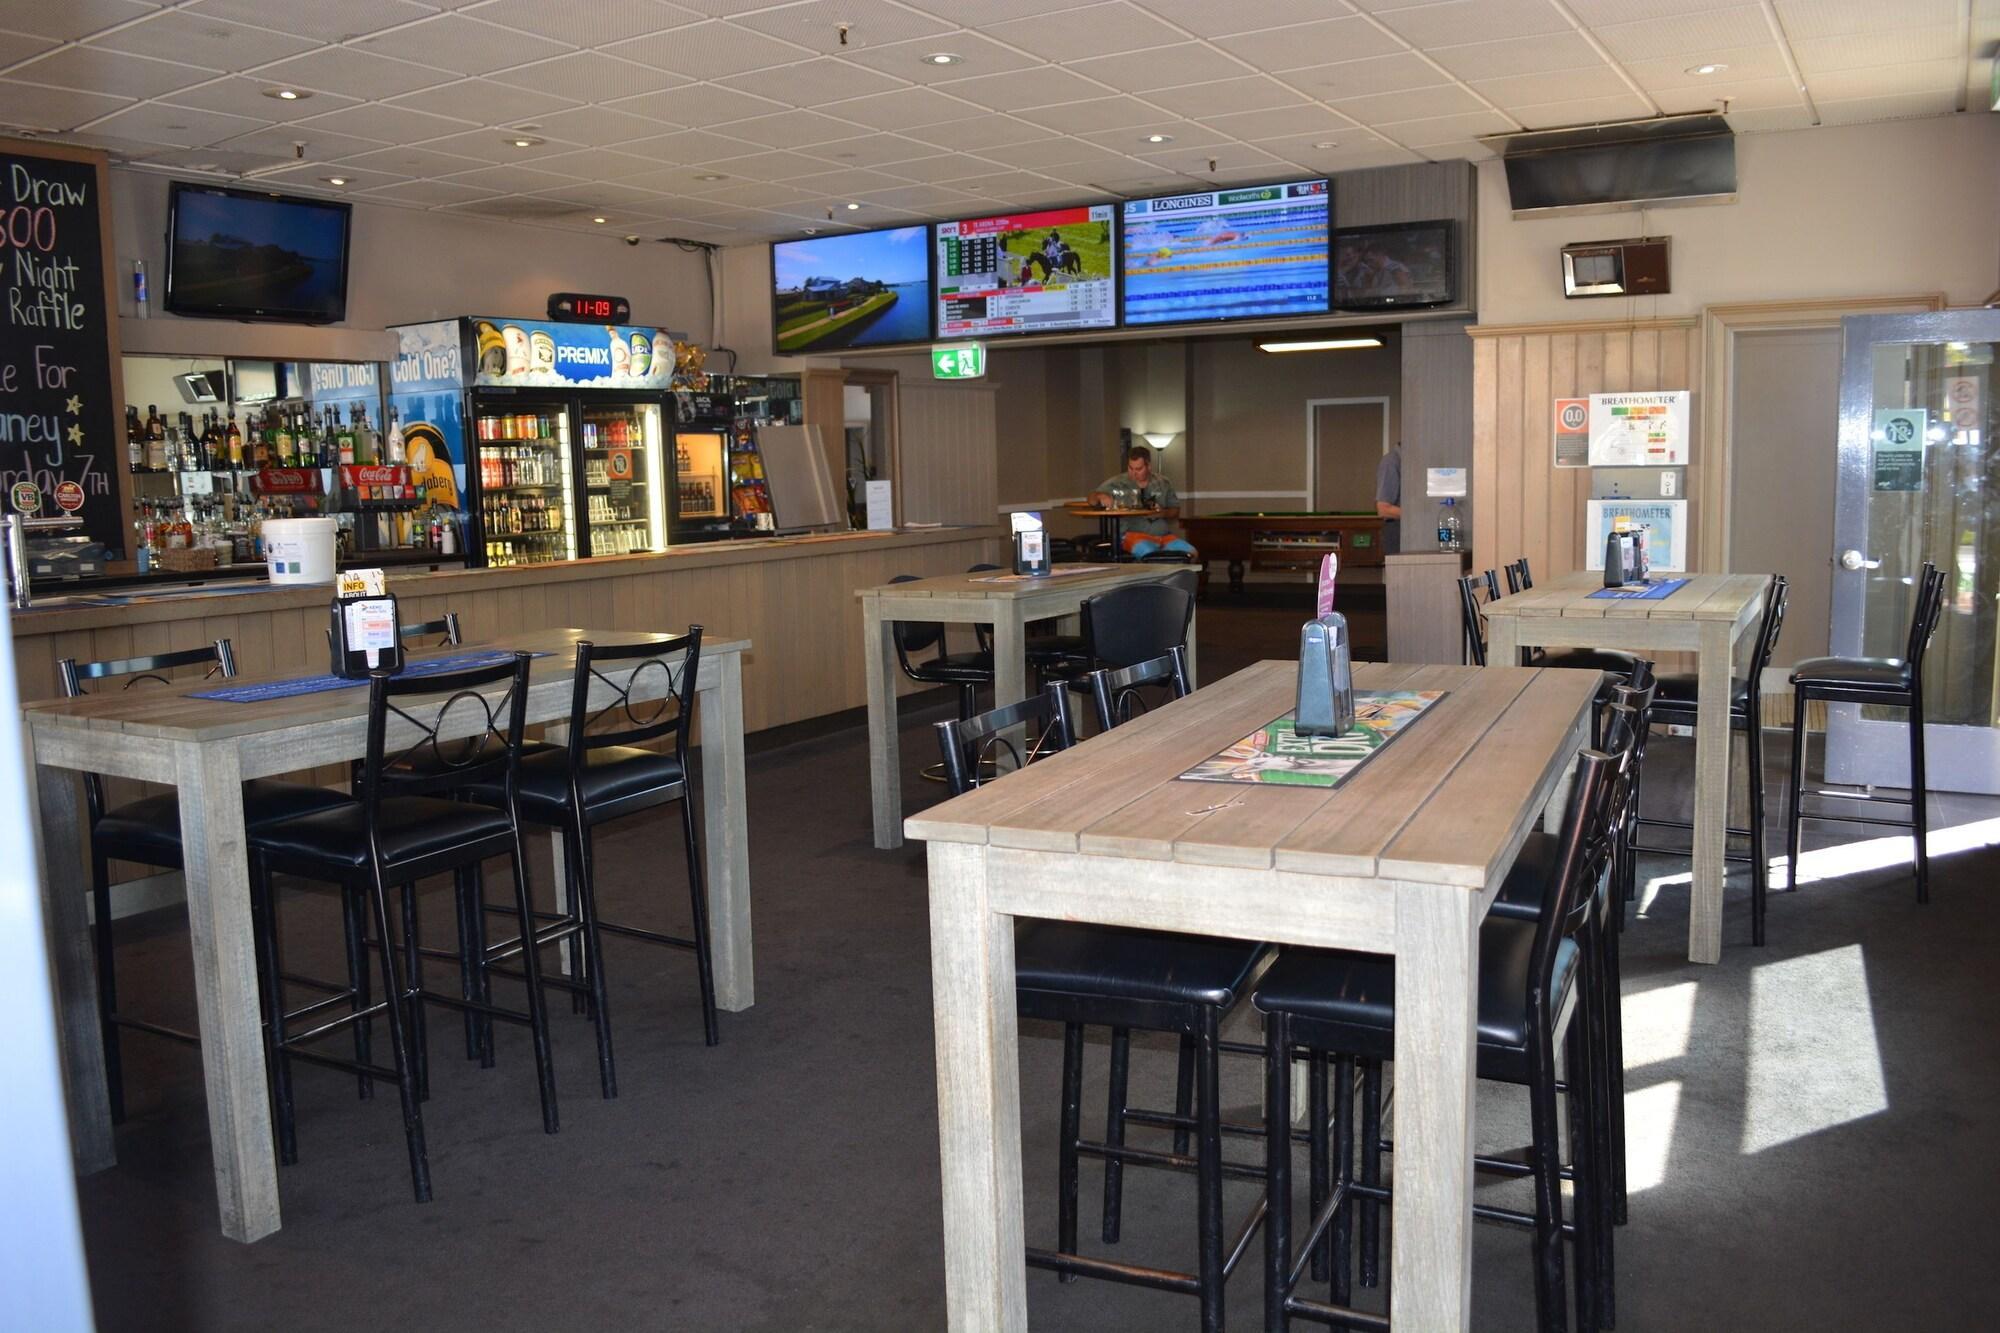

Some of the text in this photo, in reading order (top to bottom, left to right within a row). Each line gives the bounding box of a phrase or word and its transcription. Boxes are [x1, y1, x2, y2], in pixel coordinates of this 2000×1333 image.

[11, 164, 86, 206] Draw
[1154, 195, 1211, 210] LONGINES
[962, 223, 969, 234] 3
[16, 249, 80, 303] Night
[9, 286, 86, 330] Raffle
[557, 345, 611, 366] PREMIX
[35, 345, 77, 390] For
[393, 348, 457, 383] Cold One?
[1601, 395, 1676, 406] BREATHOMETER
[0, 450, 64, 508] rday
[359, 467, 394, 483] Coca-Cola
[20, 492, 34, 501] VB
[1603, 506, 1671, 520] BREATHOMETER
[344, 582, 365, 591] INFO
